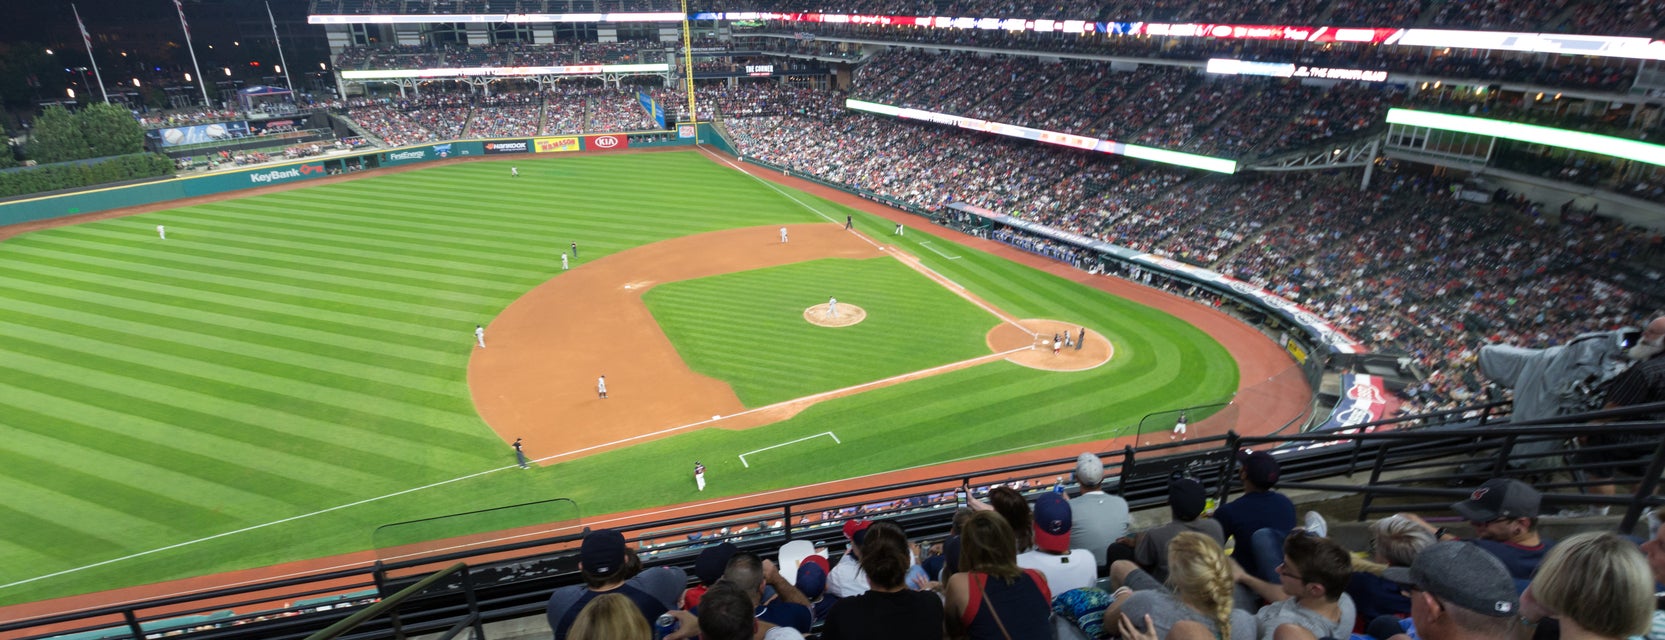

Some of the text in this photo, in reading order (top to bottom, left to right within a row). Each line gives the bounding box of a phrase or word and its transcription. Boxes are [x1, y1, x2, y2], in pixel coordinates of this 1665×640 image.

[745, 65, 774, 73] THE CORNER
[599, 137, 615, 146] KIA
[250, 168, 300, 183] KeyBank
